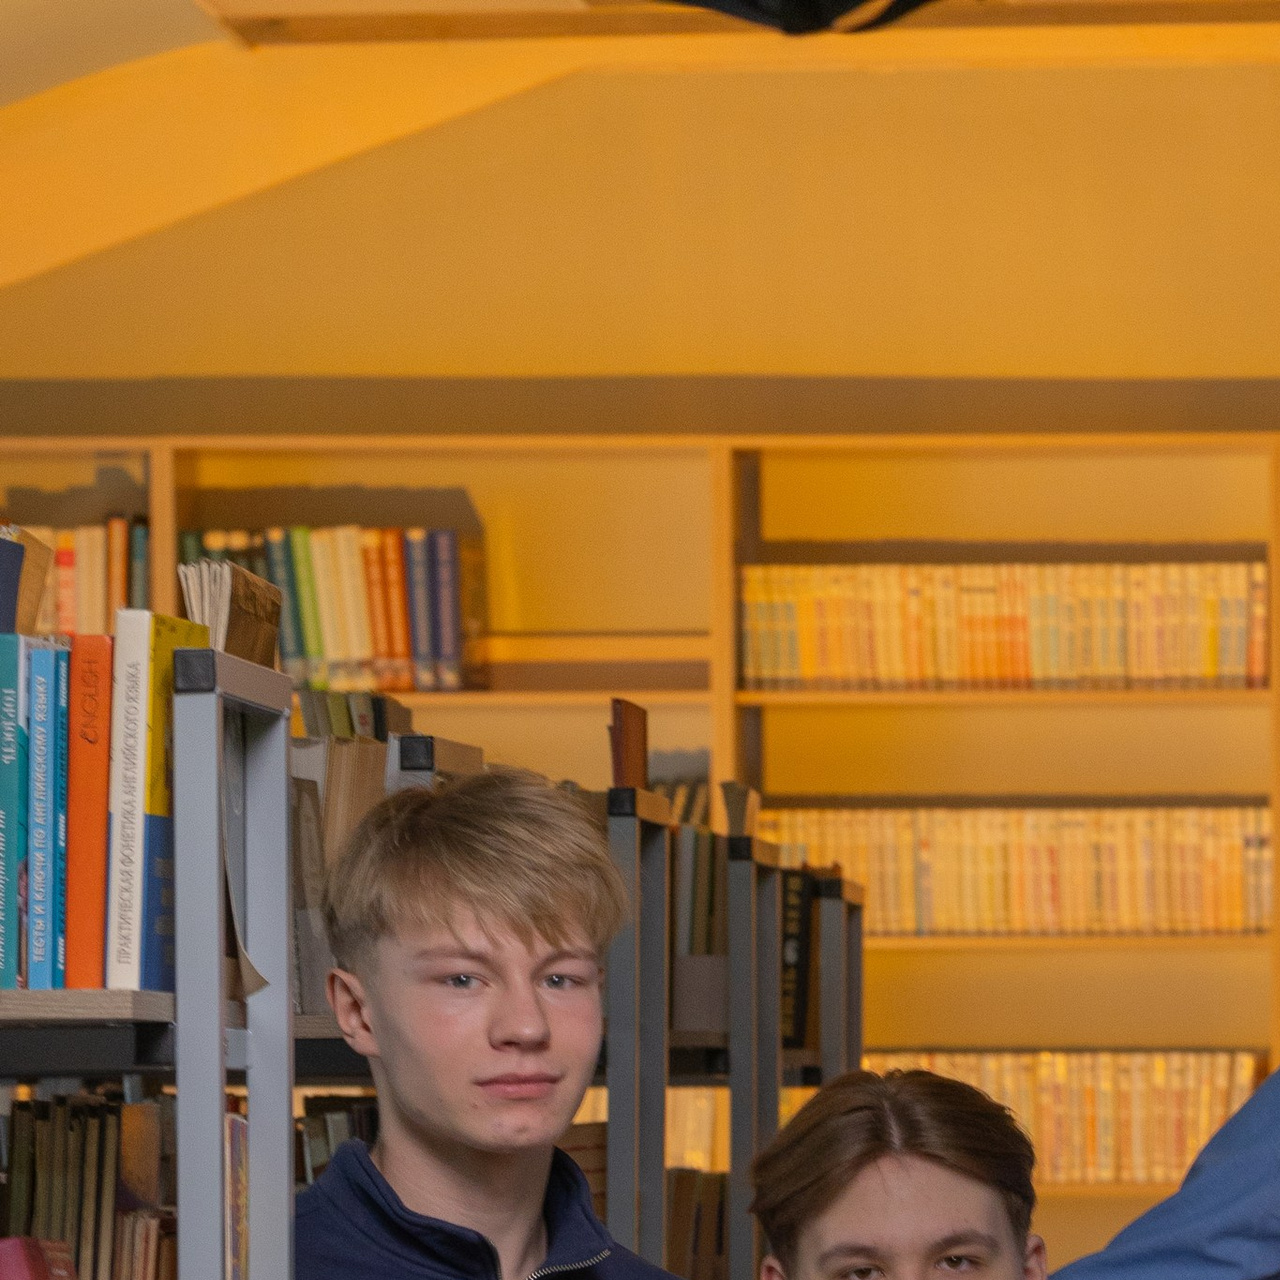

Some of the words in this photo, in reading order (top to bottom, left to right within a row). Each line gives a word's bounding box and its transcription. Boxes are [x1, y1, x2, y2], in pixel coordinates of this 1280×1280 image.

[35, 675, 48, 723] ЯЗЫКУ
[126, 661, 141, 705] ЯЗЫКА
[33, 726, 47, 826] АНГЛИЙСКОМУ
[121, 706, 139, 797] АНГЛИЙСКОГО
[33, 829, 46, 849] ПО
[118, 799, 137, 868] ФОНЕТИКА
[33, 852, 46, 902] КЛЮЧИ
[33, 918, 46, 963] ТЕСТЫ
[116, 868, 133, 966] ПРАКТИЧЕСКАЯ
